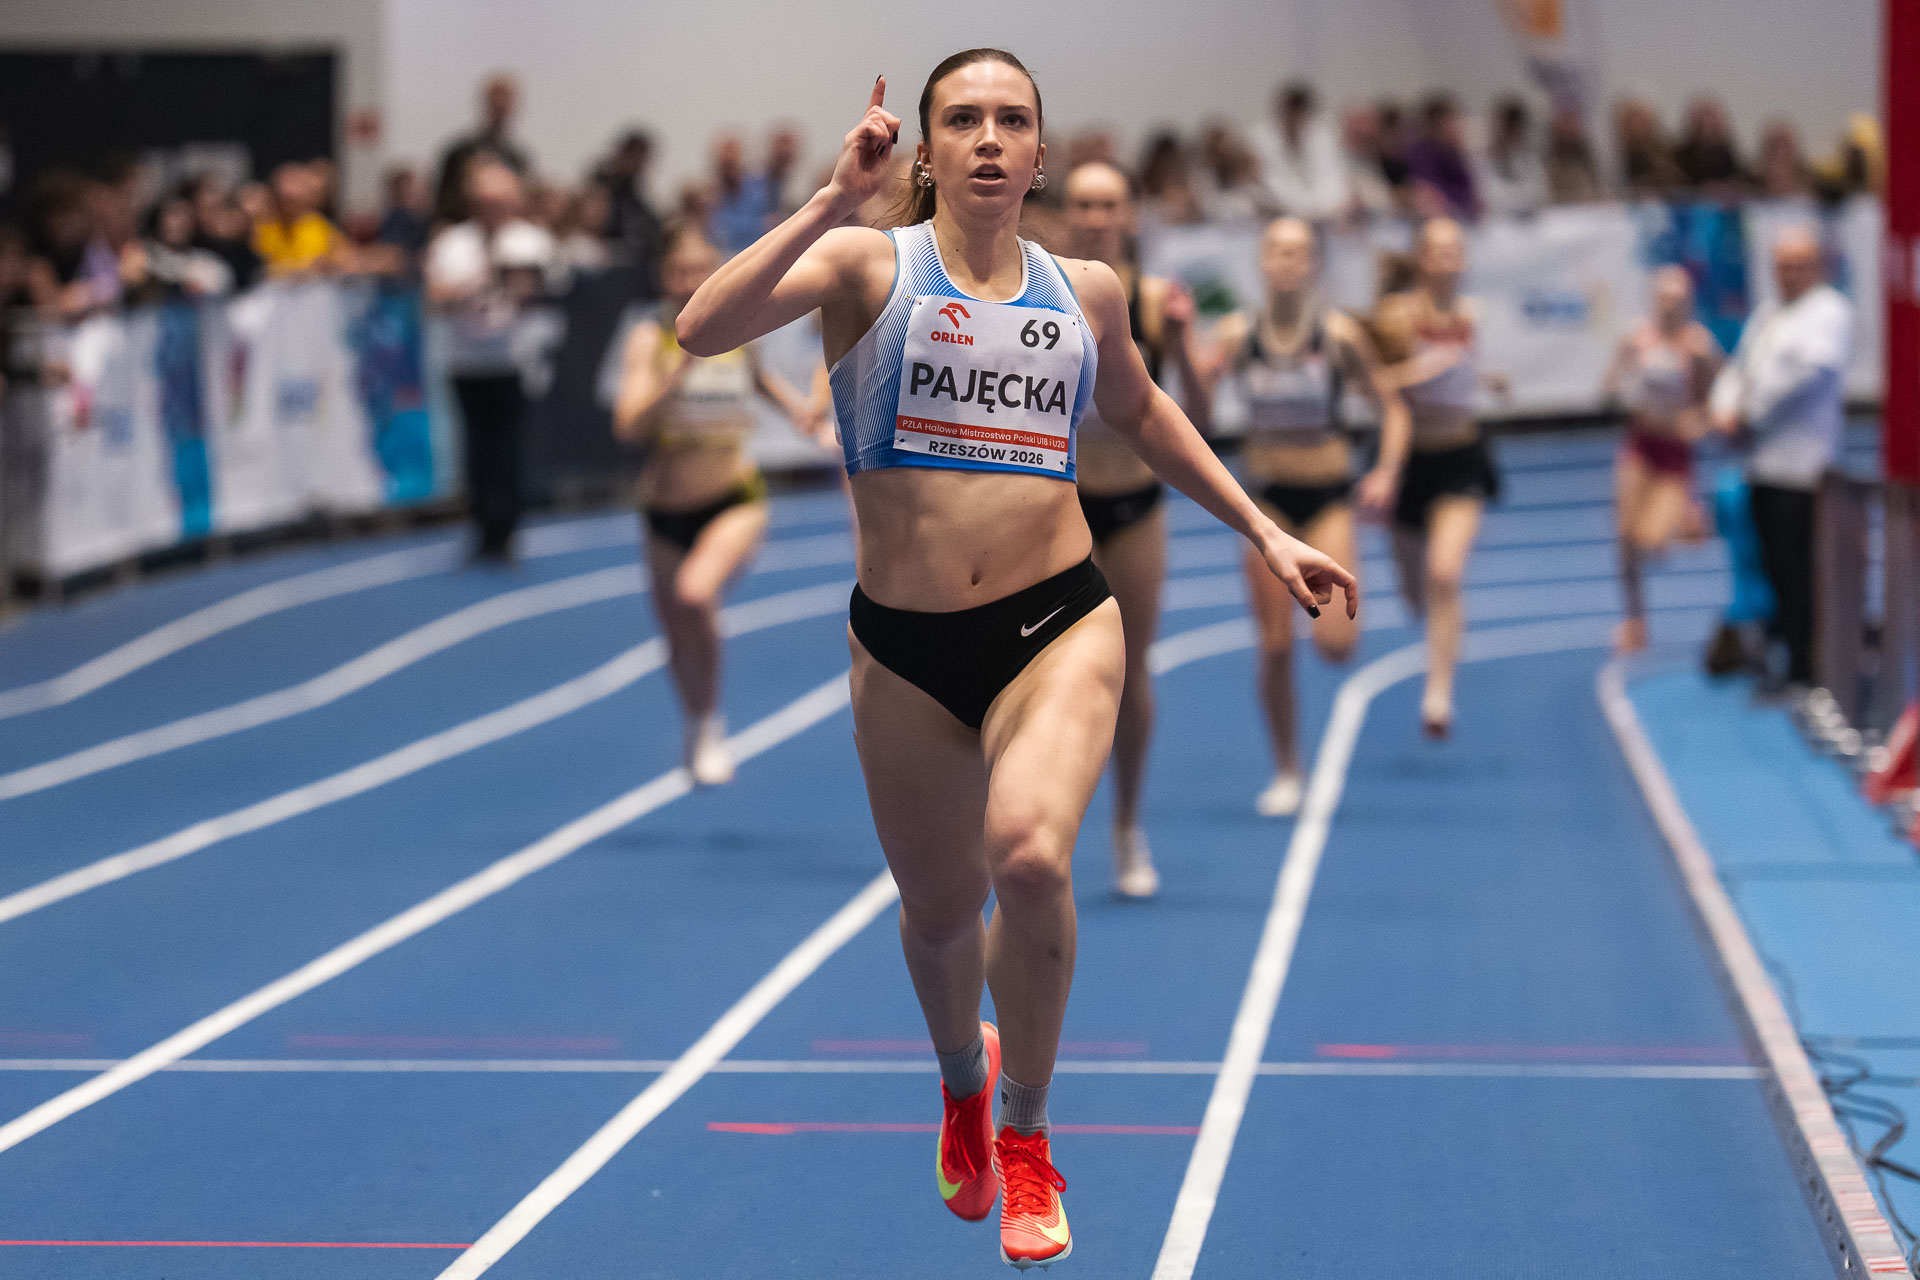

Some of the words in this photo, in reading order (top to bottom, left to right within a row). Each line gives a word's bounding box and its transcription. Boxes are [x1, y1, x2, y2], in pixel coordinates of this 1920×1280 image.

[931, 331, 973, 346] ORLEN
[1020, 319, 1060, 350] 69
[910, 362, 1066, 415] PAJĘCKA
[902, 420, 922, 431] PZLA
[925, 424, 958, 435] Halowe
[960, 428, 1011, 441] Mistrzostwa
[1013, 434, 1035, 444] Polski
[1037, 437, 1048, 445] U18
[1052, 439, 1065, 448] U20
[929, 440, 1006, 460] RZESZÓW
[1010, 450, 1044, 465] 2026
